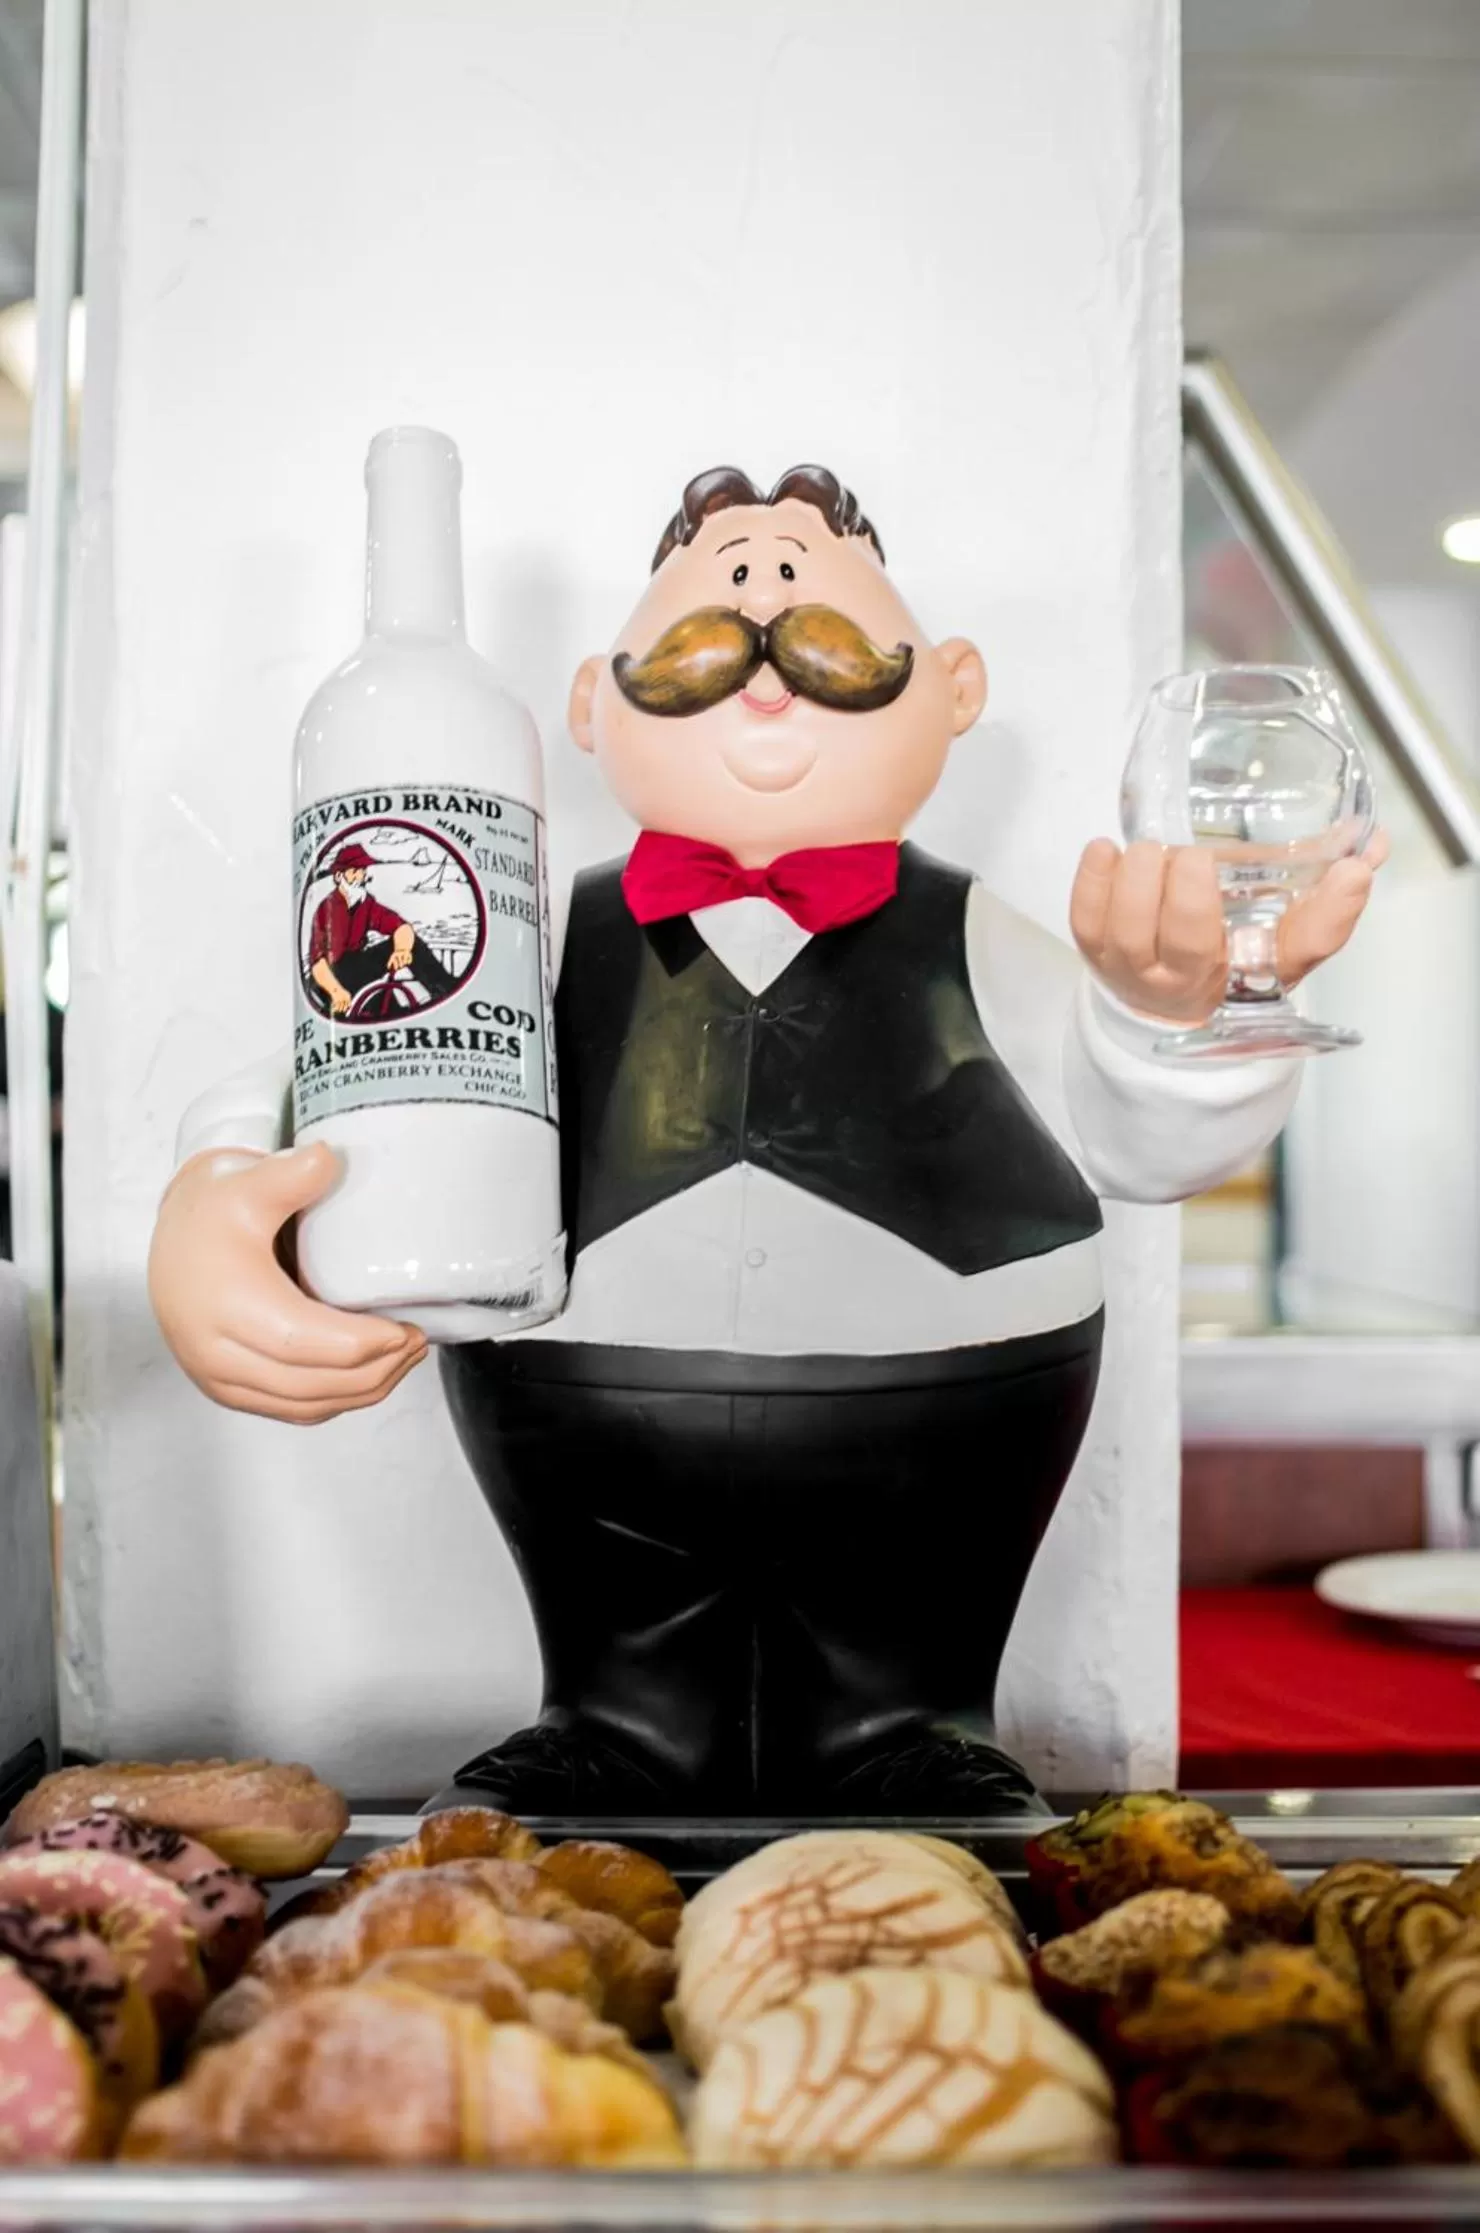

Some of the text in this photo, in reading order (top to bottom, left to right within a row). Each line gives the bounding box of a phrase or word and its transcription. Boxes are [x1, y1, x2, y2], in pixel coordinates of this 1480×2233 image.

[402, 793, 502, 819] BRAND
[435, 817, 476, 848] MARK
[474, 847, 535, 887] STANDARD
[489, 889, 538, 928] BARREL
[467, 1001, 536, 1033] COD
[333, 1064, 432, 1089] CRANBERRY
